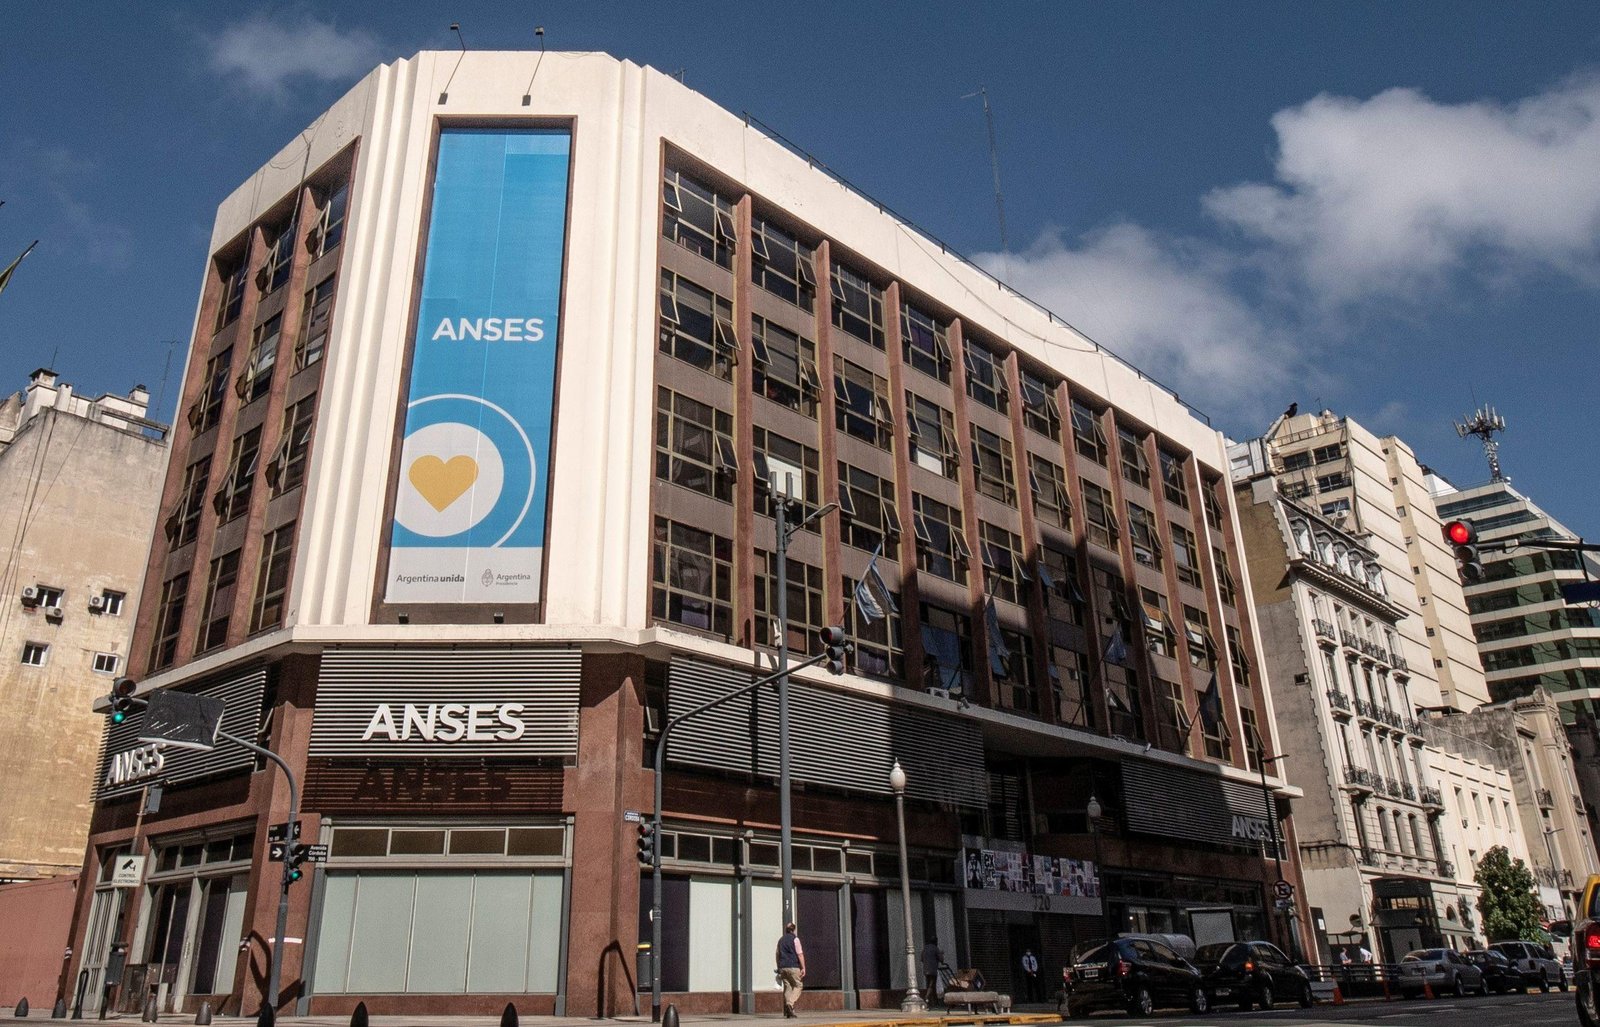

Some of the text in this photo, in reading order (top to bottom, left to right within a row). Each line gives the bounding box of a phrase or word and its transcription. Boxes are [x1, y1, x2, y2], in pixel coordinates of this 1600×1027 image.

[432, 317, 544, 342] ANSES
[396, 574, 465, 584] Argentina unida
[496, 573, 531, 581] Argentina
[361, 703, 525, 742] ANSES
[104, 743, 164, 787] ANSES
[1232, 815, 1271, 841] ANSES
